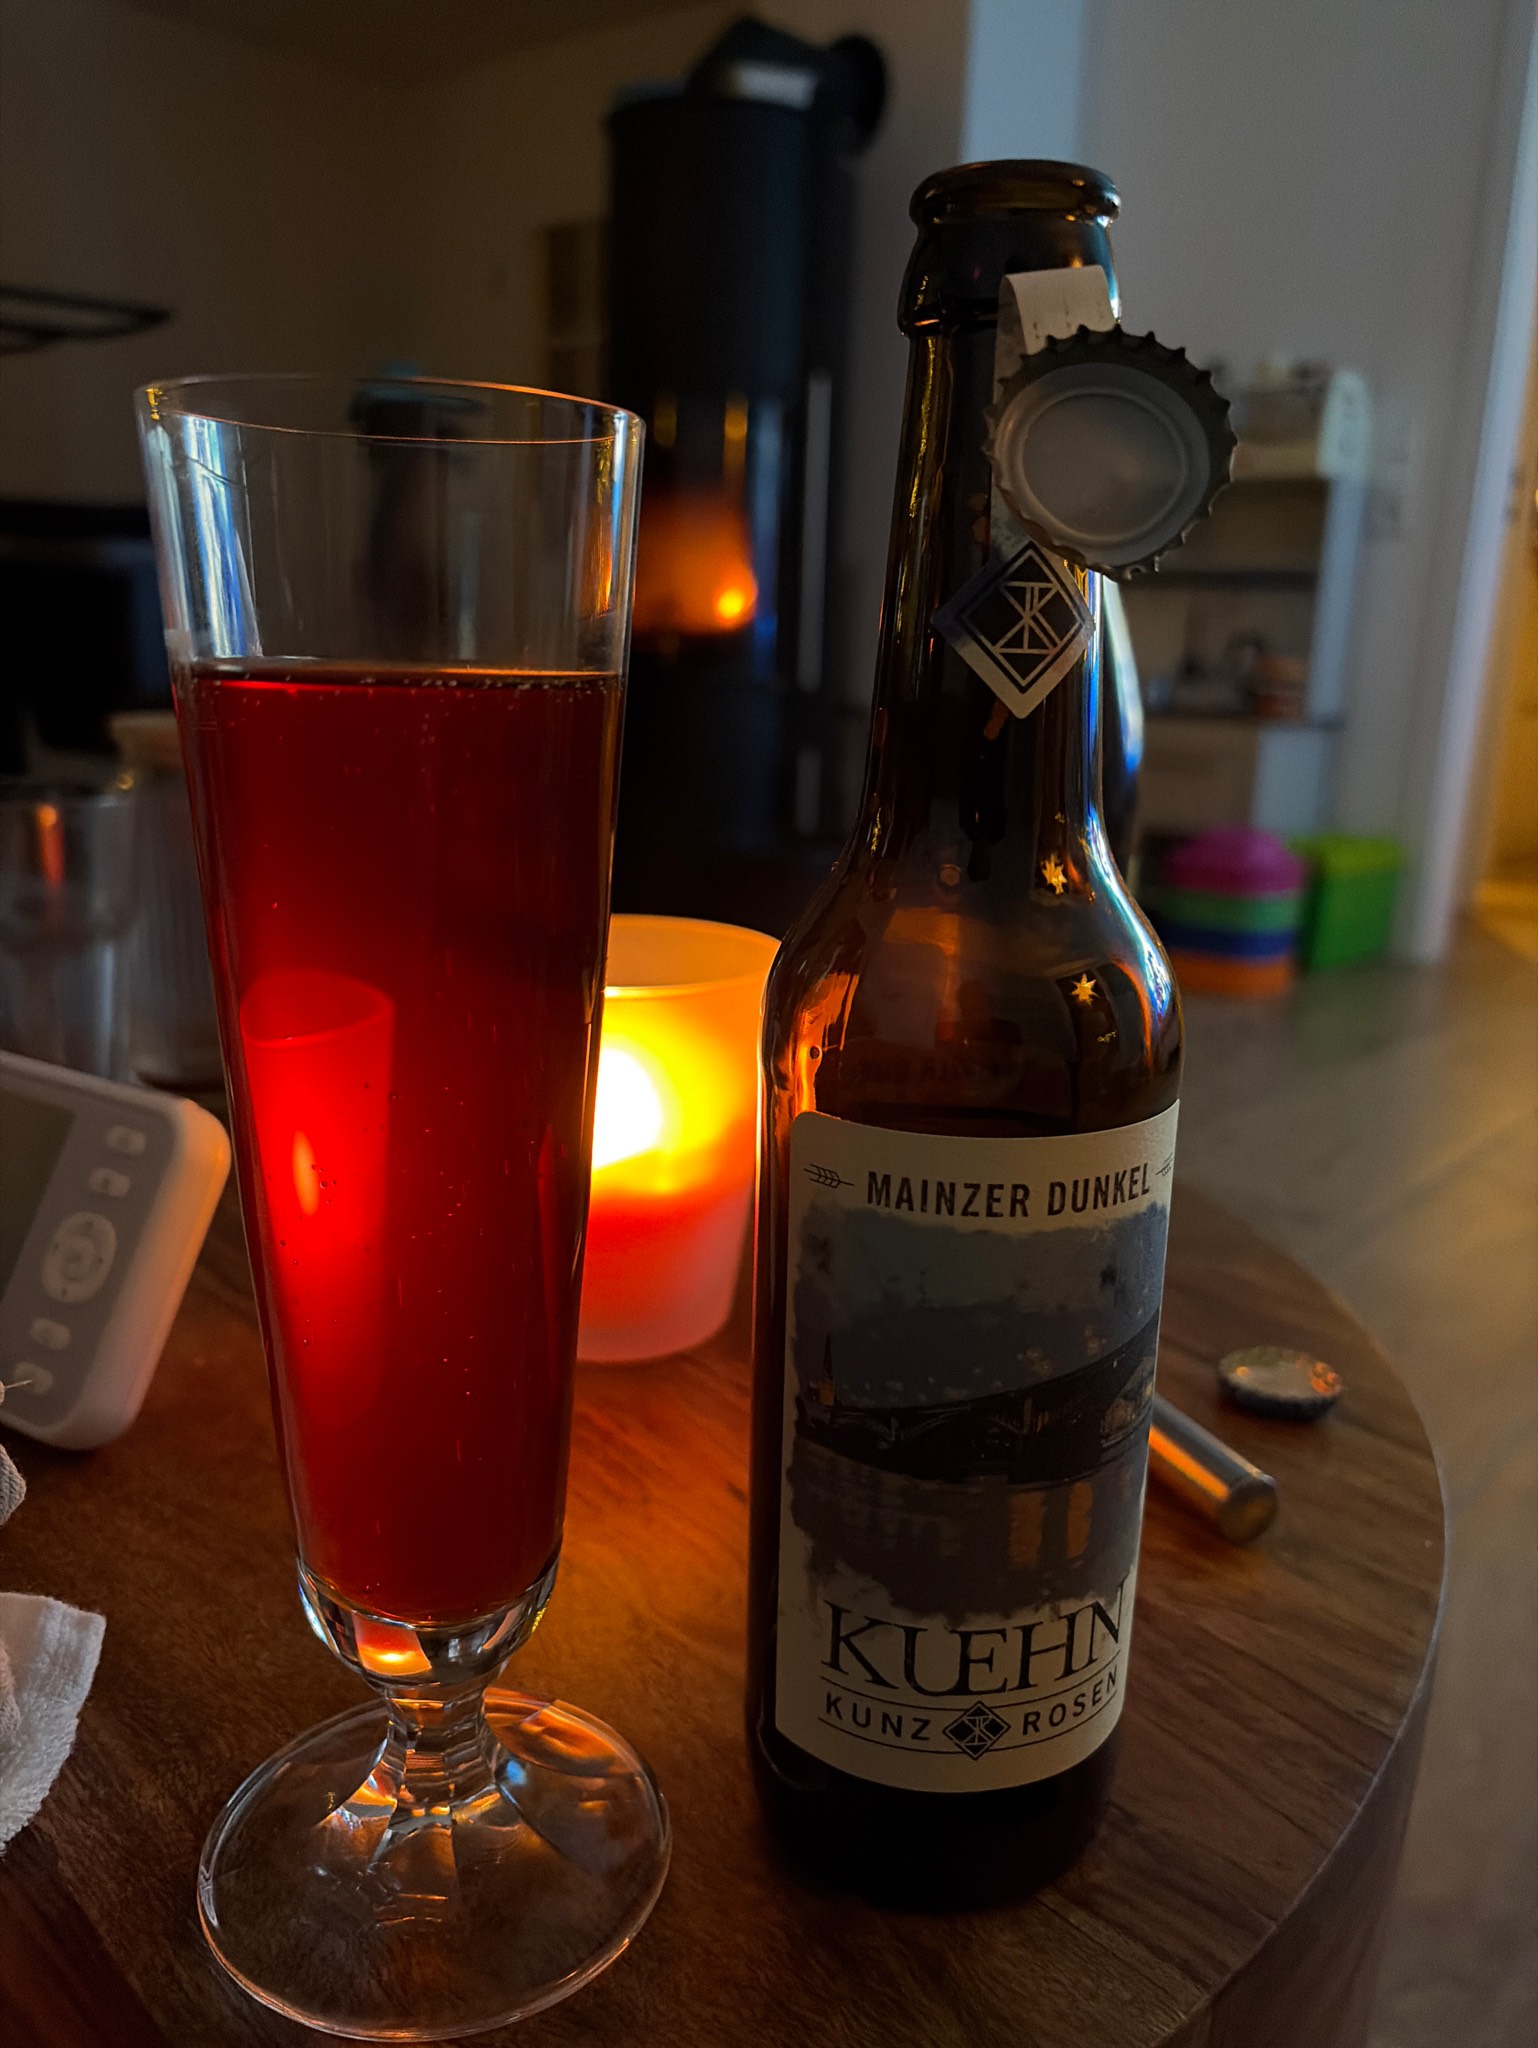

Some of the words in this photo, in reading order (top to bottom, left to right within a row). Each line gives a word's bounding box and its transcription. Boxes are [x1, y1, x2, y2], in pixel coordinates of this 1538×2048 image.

[867, 1171, 1030, 1218] MAINZER
[1046, 1162, 1151, 1216] DUNKEL
[820, 1572, 1132, 1697] KUEHN
[826, 1691, 930, 1741] KUNZ
[1022, 1664, 1117, 1736] ROSEN
